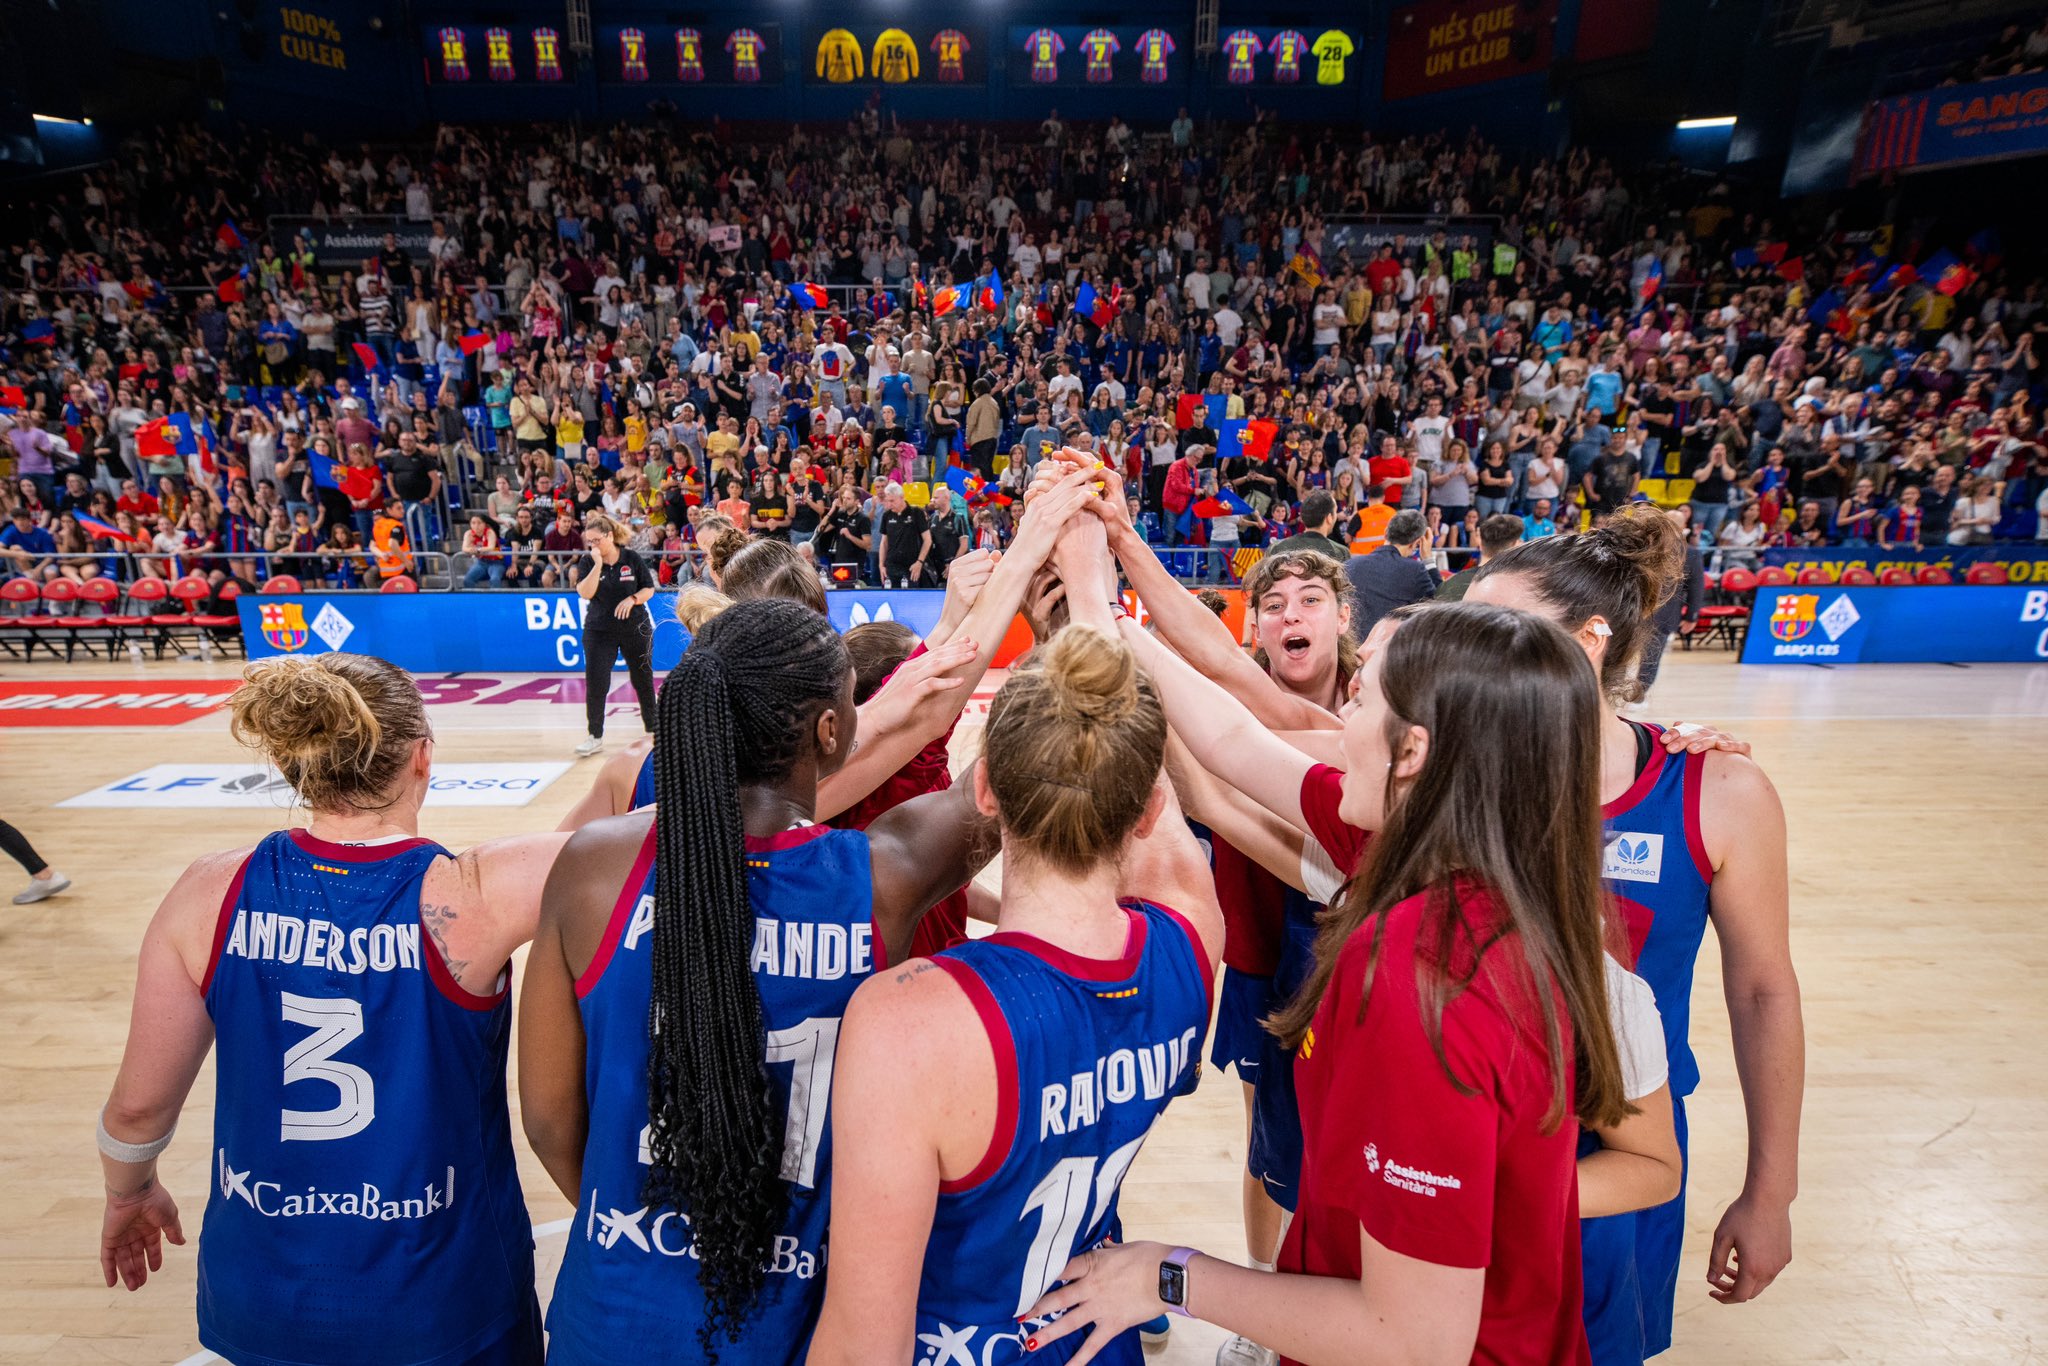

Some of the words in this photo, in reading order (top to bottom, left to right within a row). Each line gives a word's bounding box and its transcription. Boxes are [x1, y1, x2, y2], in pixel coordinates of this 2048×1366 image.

[280, 7, 341, 42] 100%
[1428, 11, 1468, 48] MÉS
[1472, 4, 1517, 41] QUE
[280, 35, 346, 70] CULER
[626, 42, 639, 61] 7
[735, 42, 756, 61] 21
[835, 44, 844, 60] 1
[885, 44, 905, 61] 16
[1094, 43, 1106, 62] 7
[1322, 46, 1342, 62] 28
[1425, 51, 1455, 77] UN
[1458, 36, 1511, 69] CLUB
[107, 776, 220, 793] LF
[226, 908, 421, 975] ANDERSON
[280, 990, 376, 1143] 3
[638, 1016, 842, 1190] 1
[1383, 1169, 1437, 1198] Sanitària
[1384, 1158, 1461, 1190] Assistència
[253, 1181, 443, 1222] CaixaBank
